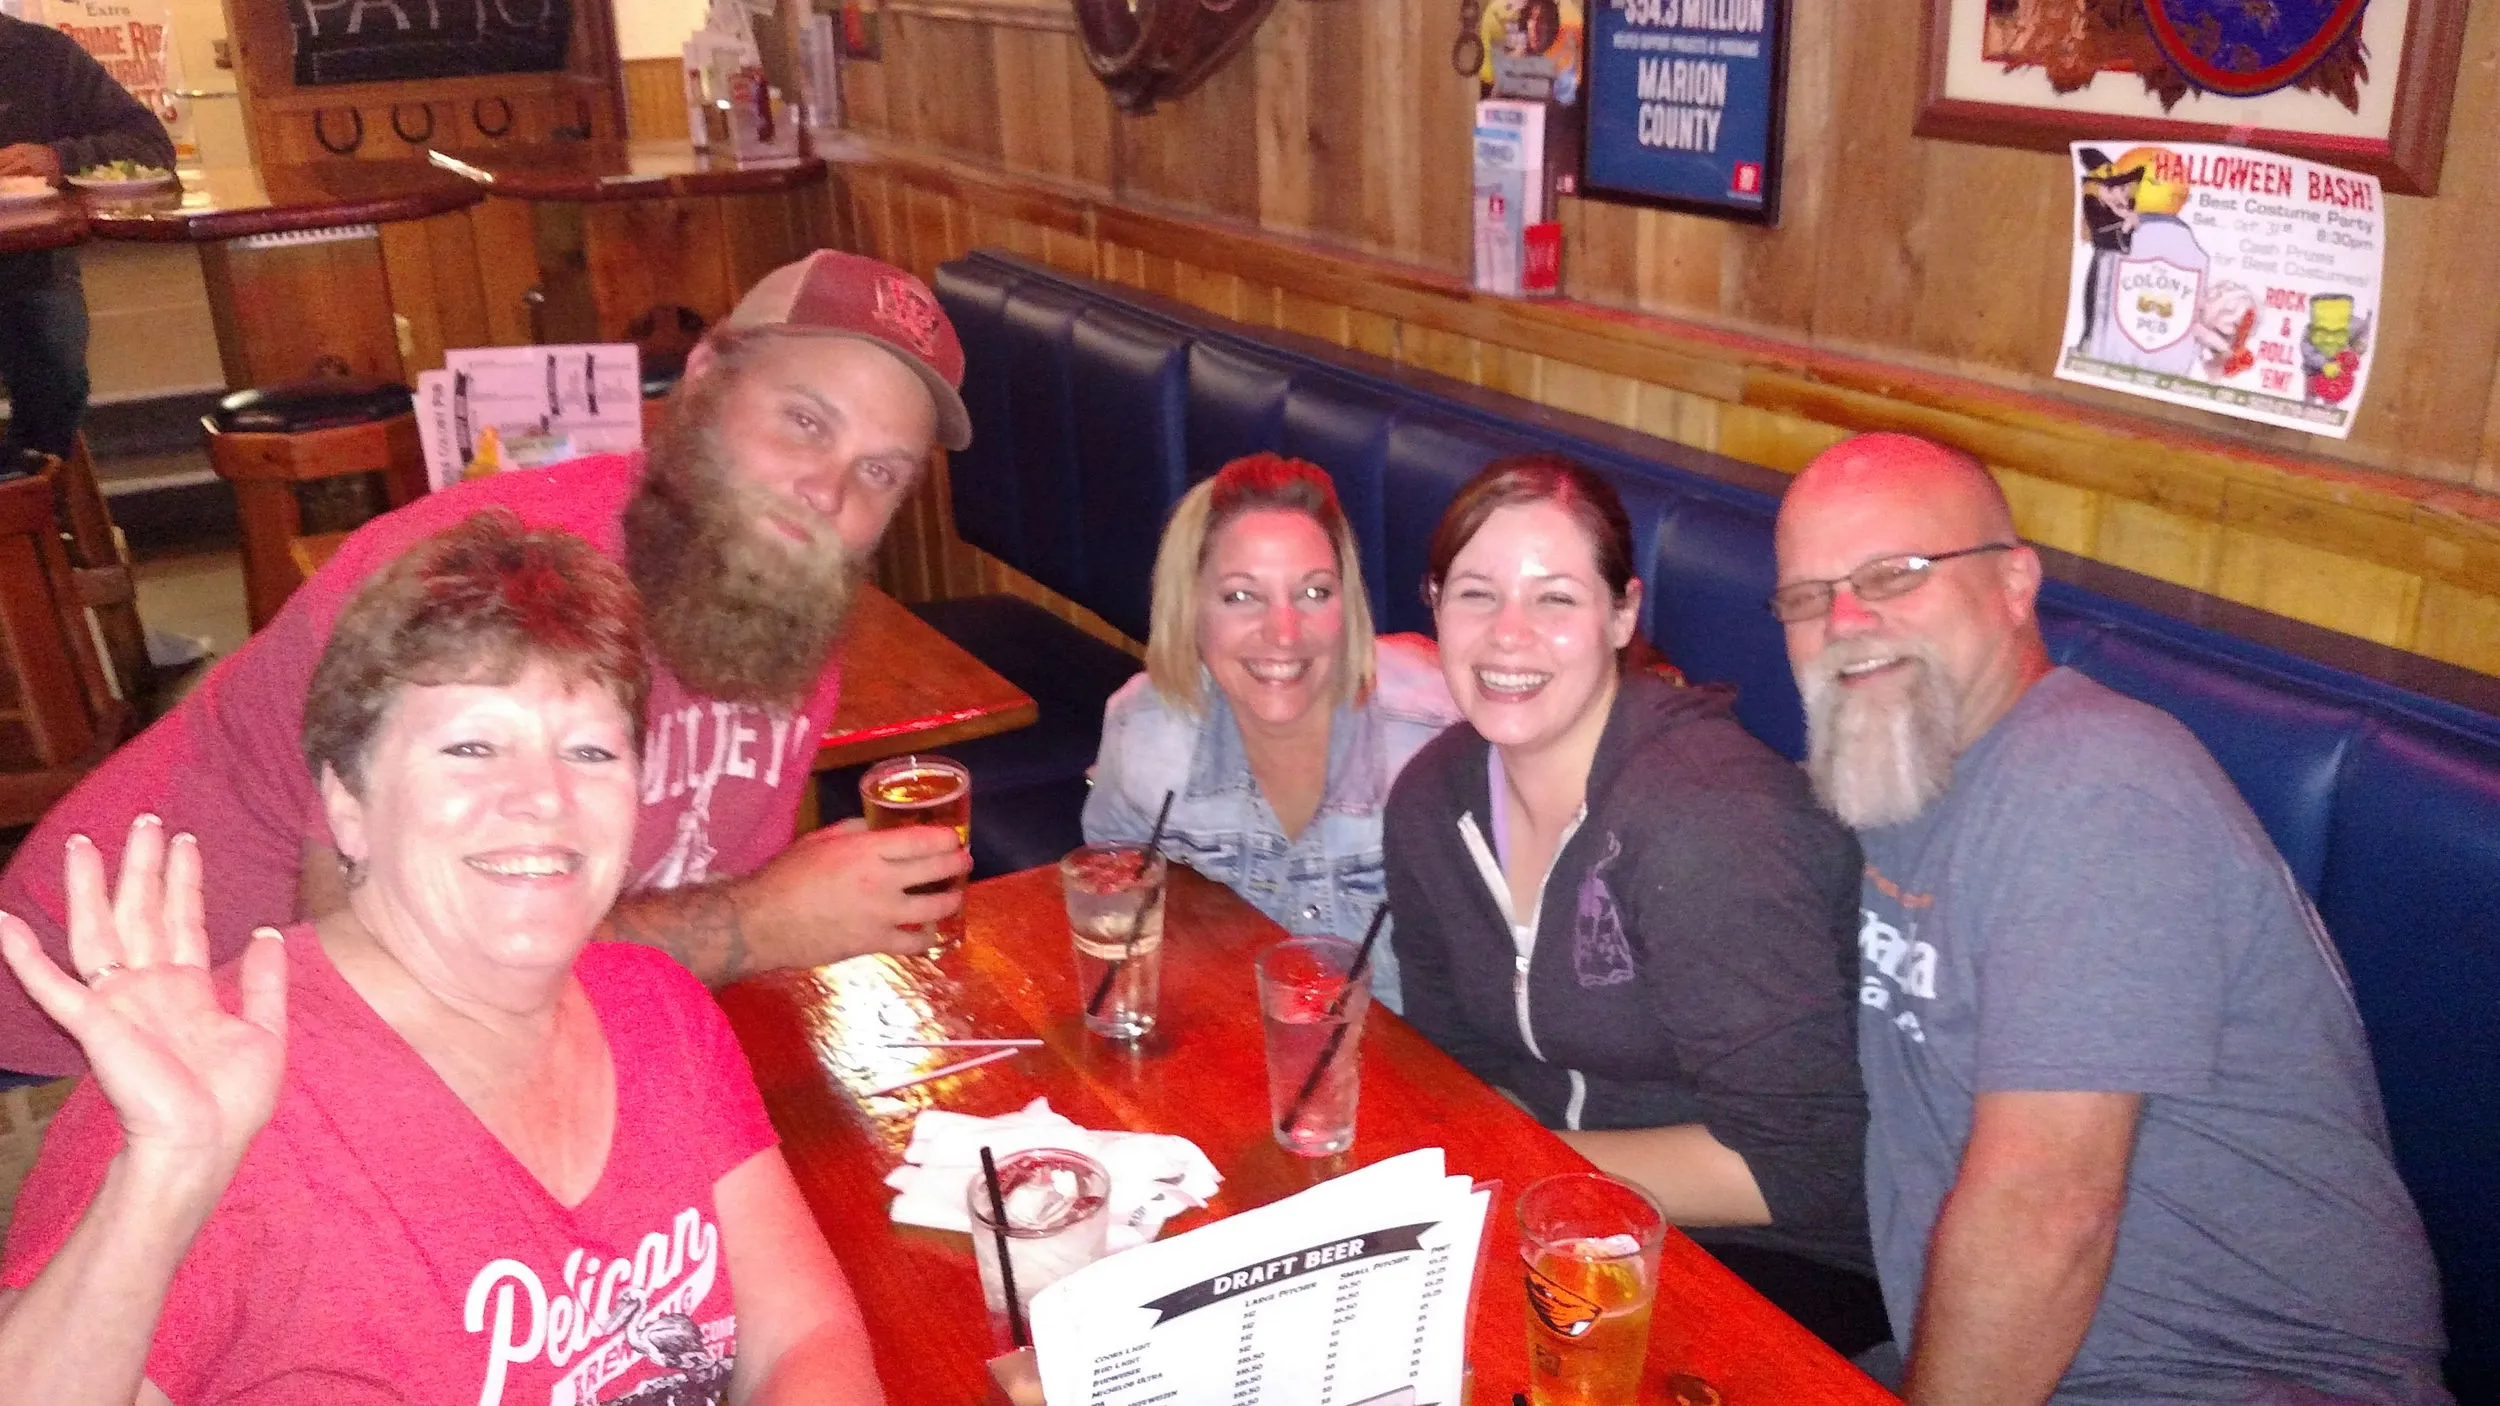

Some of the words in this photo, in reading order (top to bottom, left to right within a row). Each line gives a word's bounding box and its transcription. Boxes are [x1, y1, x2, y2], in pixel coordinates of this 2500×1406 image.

[1638, 57, 1728, 107] MARION
[1637, 102, 1722, 153] COUNTY
[2154, 153, 2293, 197] HALLOWEEN
[2307, 171, 2375, 212] BASH!
[2200, 193, 2239, 211] Best
[2244, 198, 2322, 224] Costume
[2326, 209, 2375, 235] Party
[2239, 238, 2280, 256] Cash
[2316, 228, 2375, 250] 8:30pm
[2241, 254, 2279, 274] Best
[2122, 273, 2194, 300] COLONY
[2263, 286, 2308, 313] ROCK
[2279, 316, 2292, 337] &
[2258, 340, 2294, 366] ROLL
[1213, 1257, 1298, 1295] DRAFT
[1303, 1239, 1365, 1269] BEER
[464, 1206, 718, 1406] Pelican
